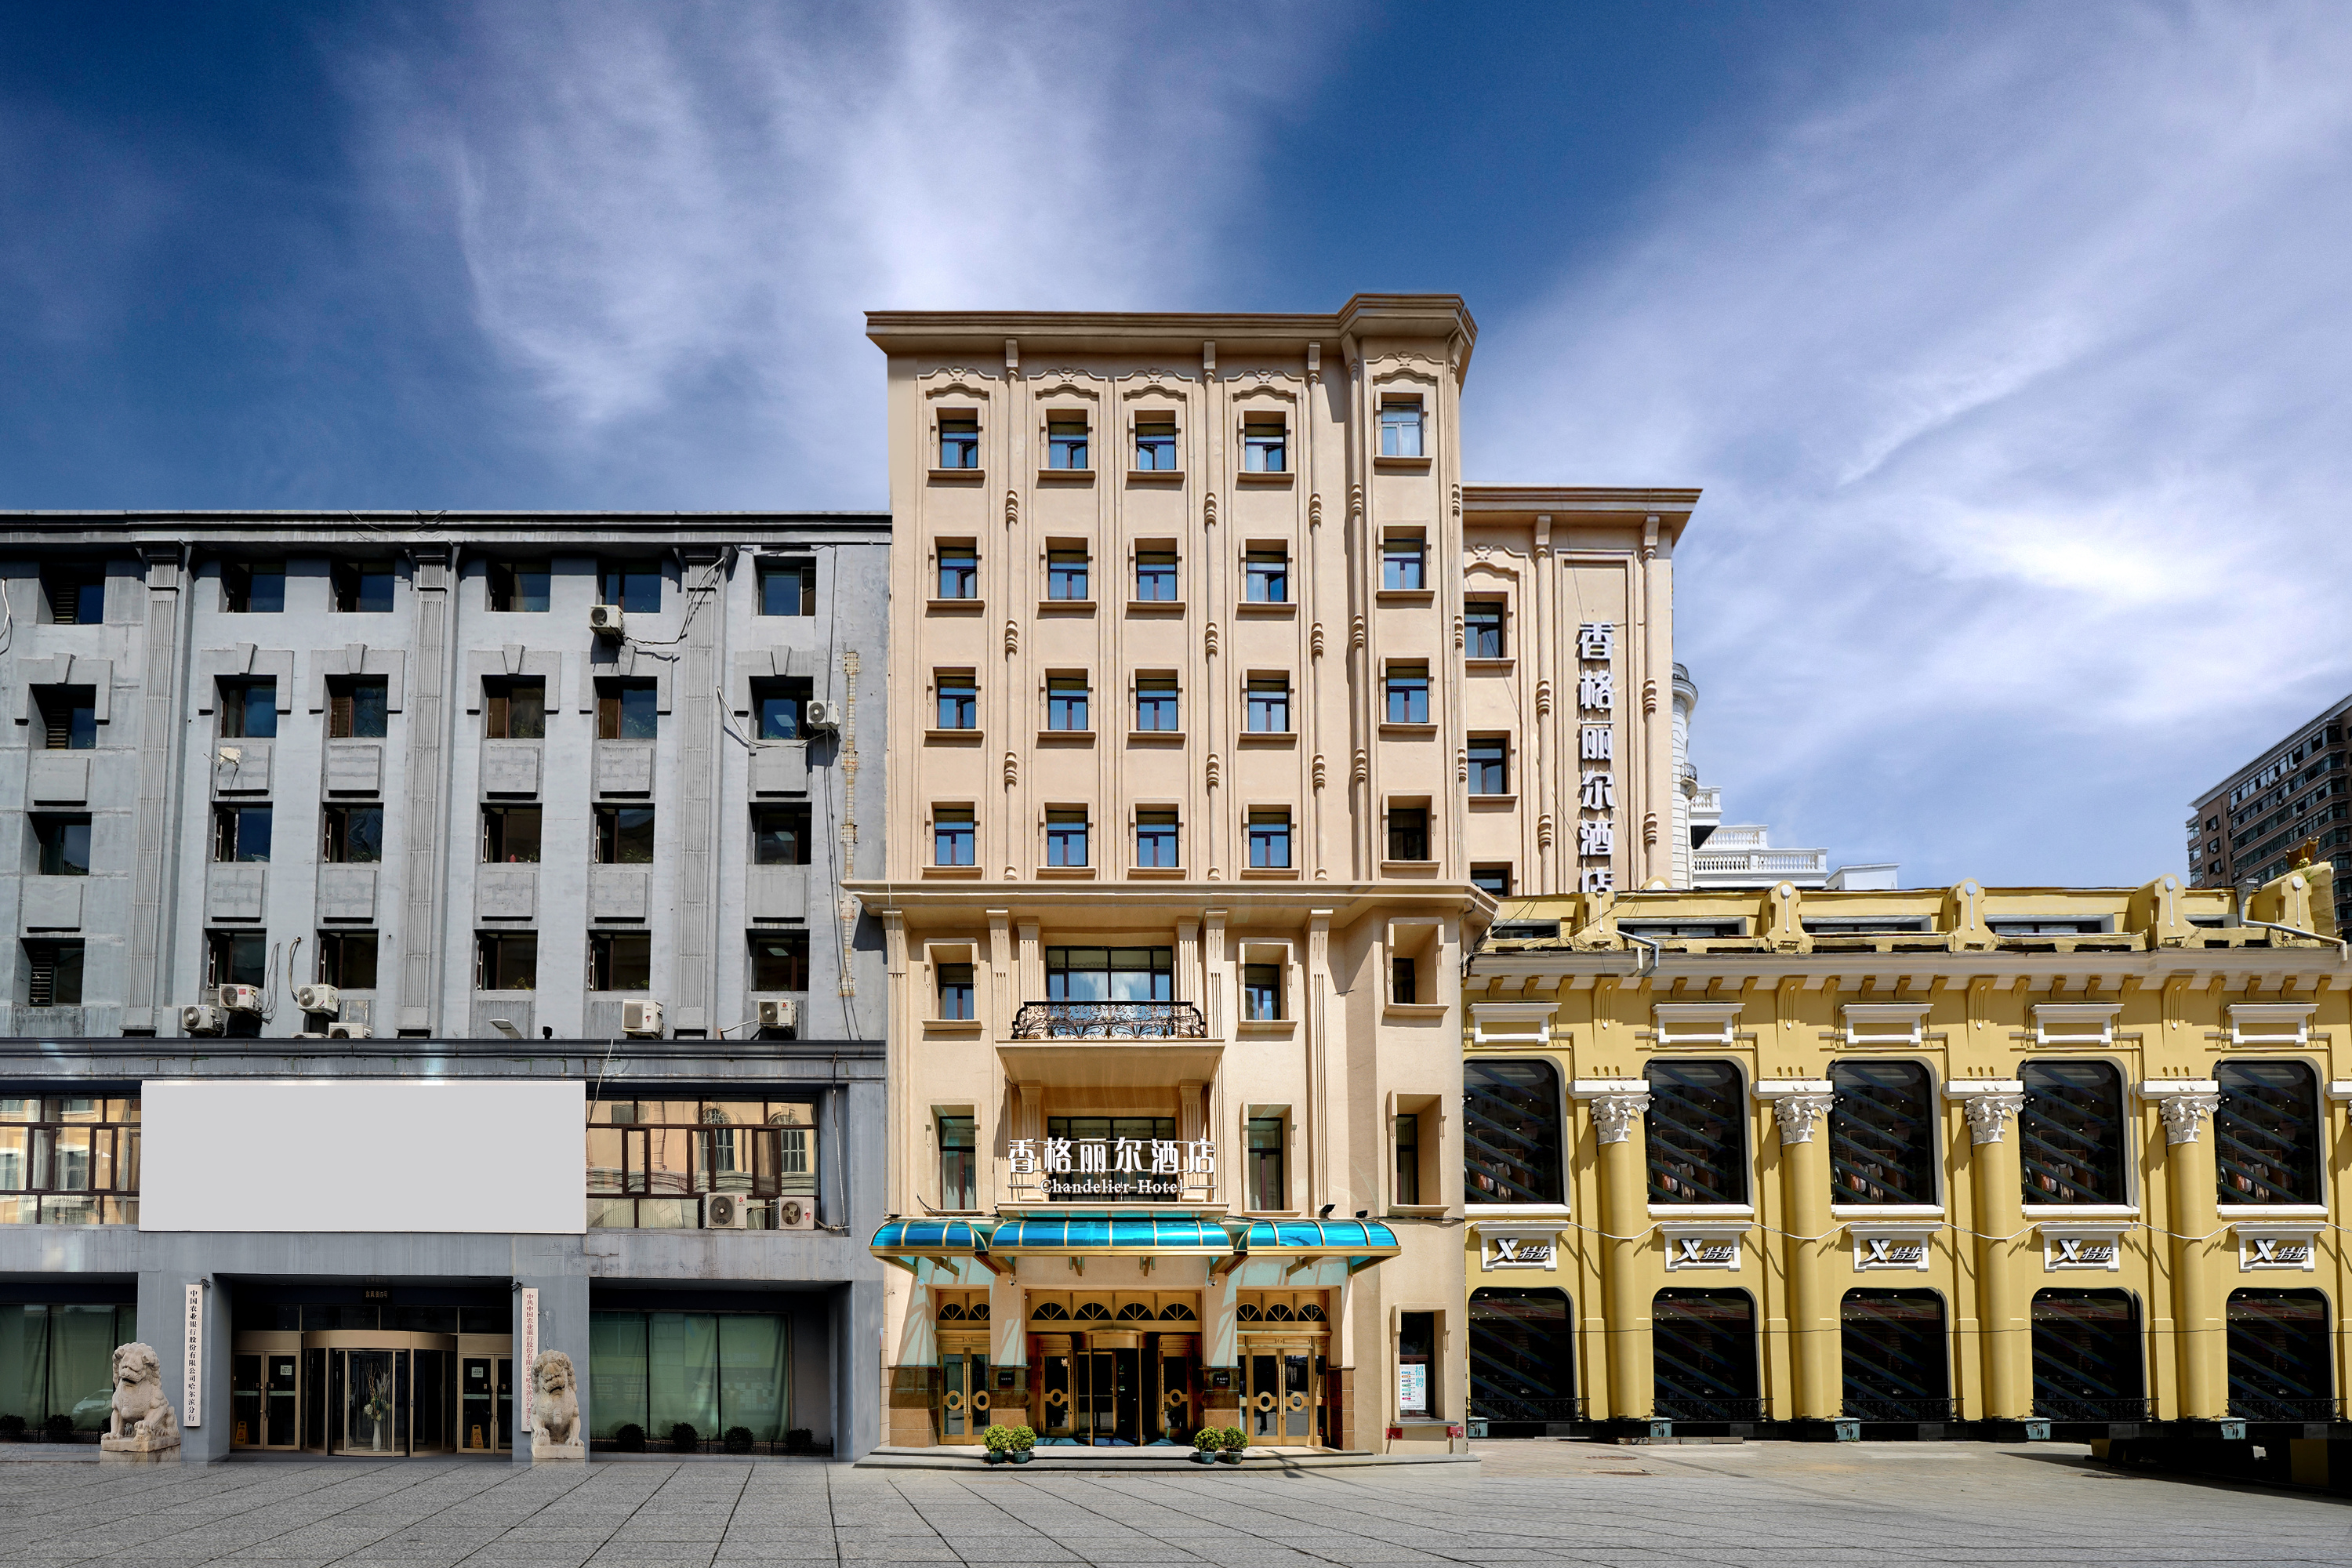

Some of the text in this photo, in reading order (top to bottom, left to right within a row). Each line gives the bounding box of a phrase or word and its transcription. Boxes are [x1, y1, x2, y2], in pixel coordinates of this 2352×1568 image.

[1579, 621, 1615, 892] 香格丽尔酒店
[1008, 1137, 1215, 1174] 香格丽尔酒店
[1040, 1178, 1184, 1194] Chandelier Hotel
[1517, 1246, 1551, 1260] 特步
[1700, 1246, 1734, 1260] 特步
[1889, 1246, 1922, 1260] 特步
[2079, 1246, 2113, 1260] 特步
[2274, 1246, 2308, 1260] 特步
[188, 1290, 198, 1421] 中国农业银行股份有限公司哈尔滨分行
[1415, 1365, 1424, 1388] 招聘
